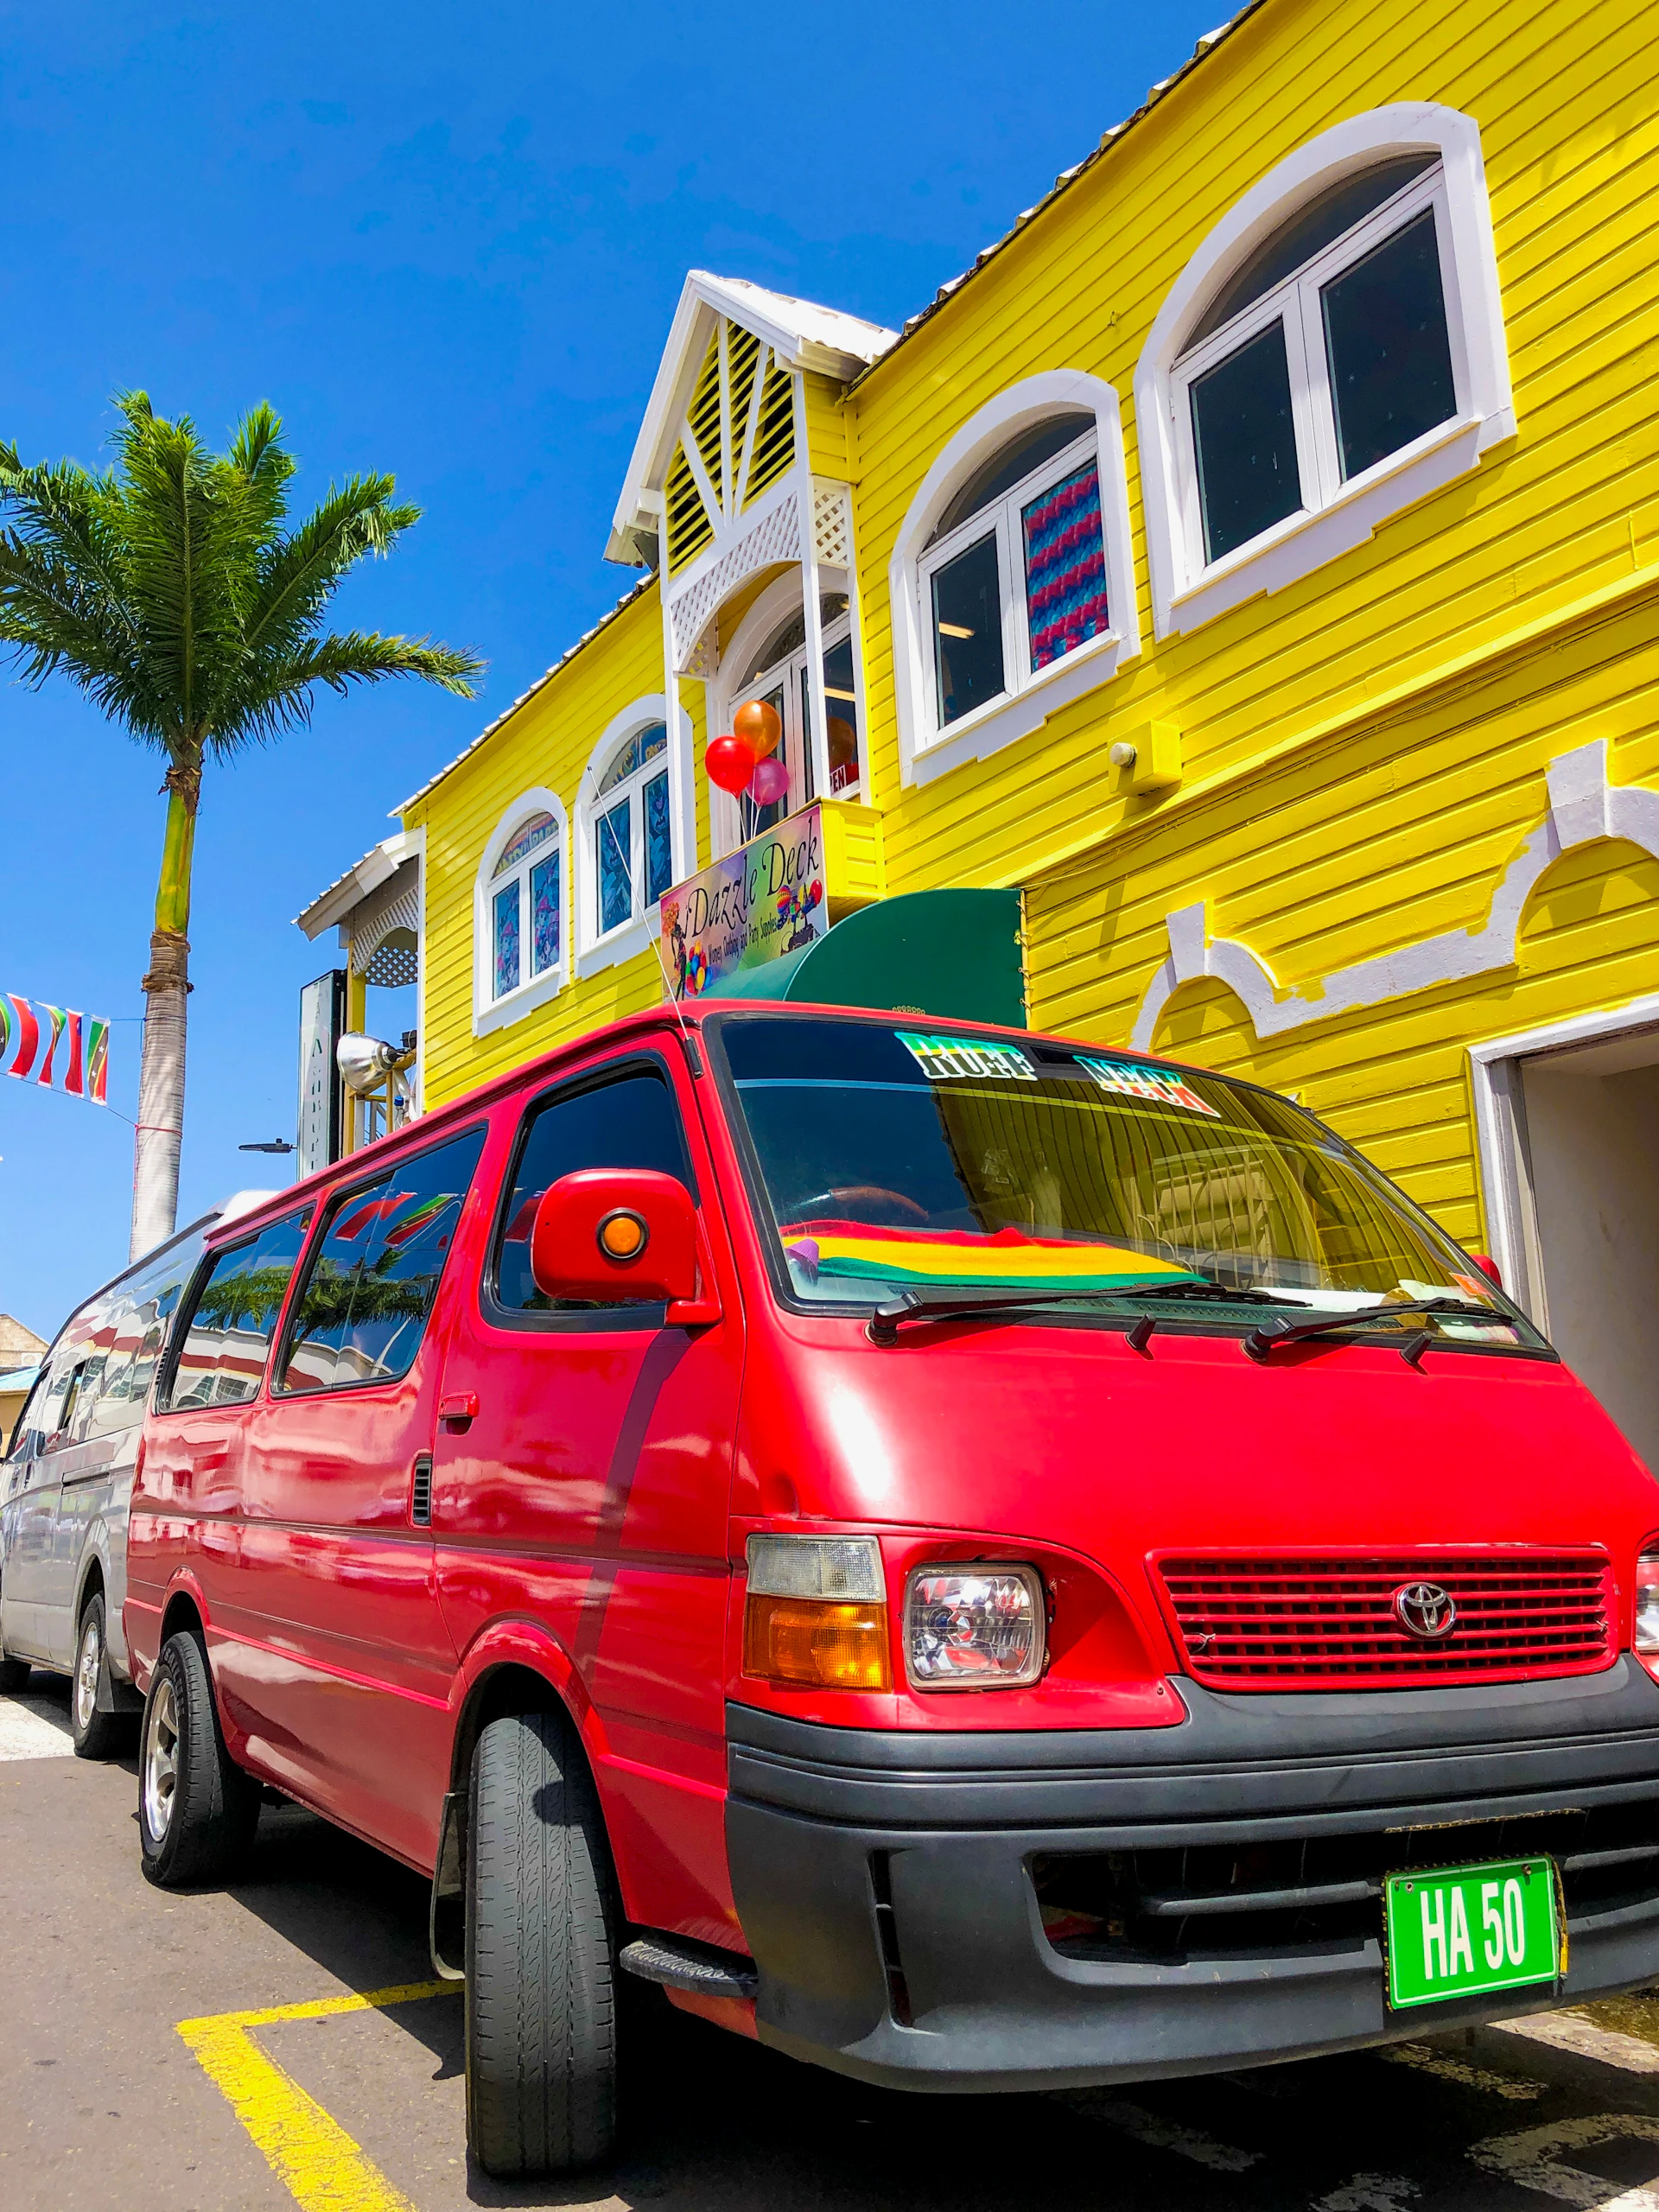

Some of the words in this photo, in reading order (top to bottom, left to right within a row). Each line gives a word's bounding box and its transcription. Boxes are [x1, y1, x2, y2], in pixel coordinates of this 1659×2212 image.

[687, 854, 758, 938] Dazzle
[761, 815, 819, 897] Deck
[748, 923, 760, 949] Party
[894, 1032, 1038, 1081] RUFF
[1073, 1055, 1222, 1118] NECK
[1421, 1885, 1474, 1980] HA
[1481, 1878, 1525, 1970] 50
